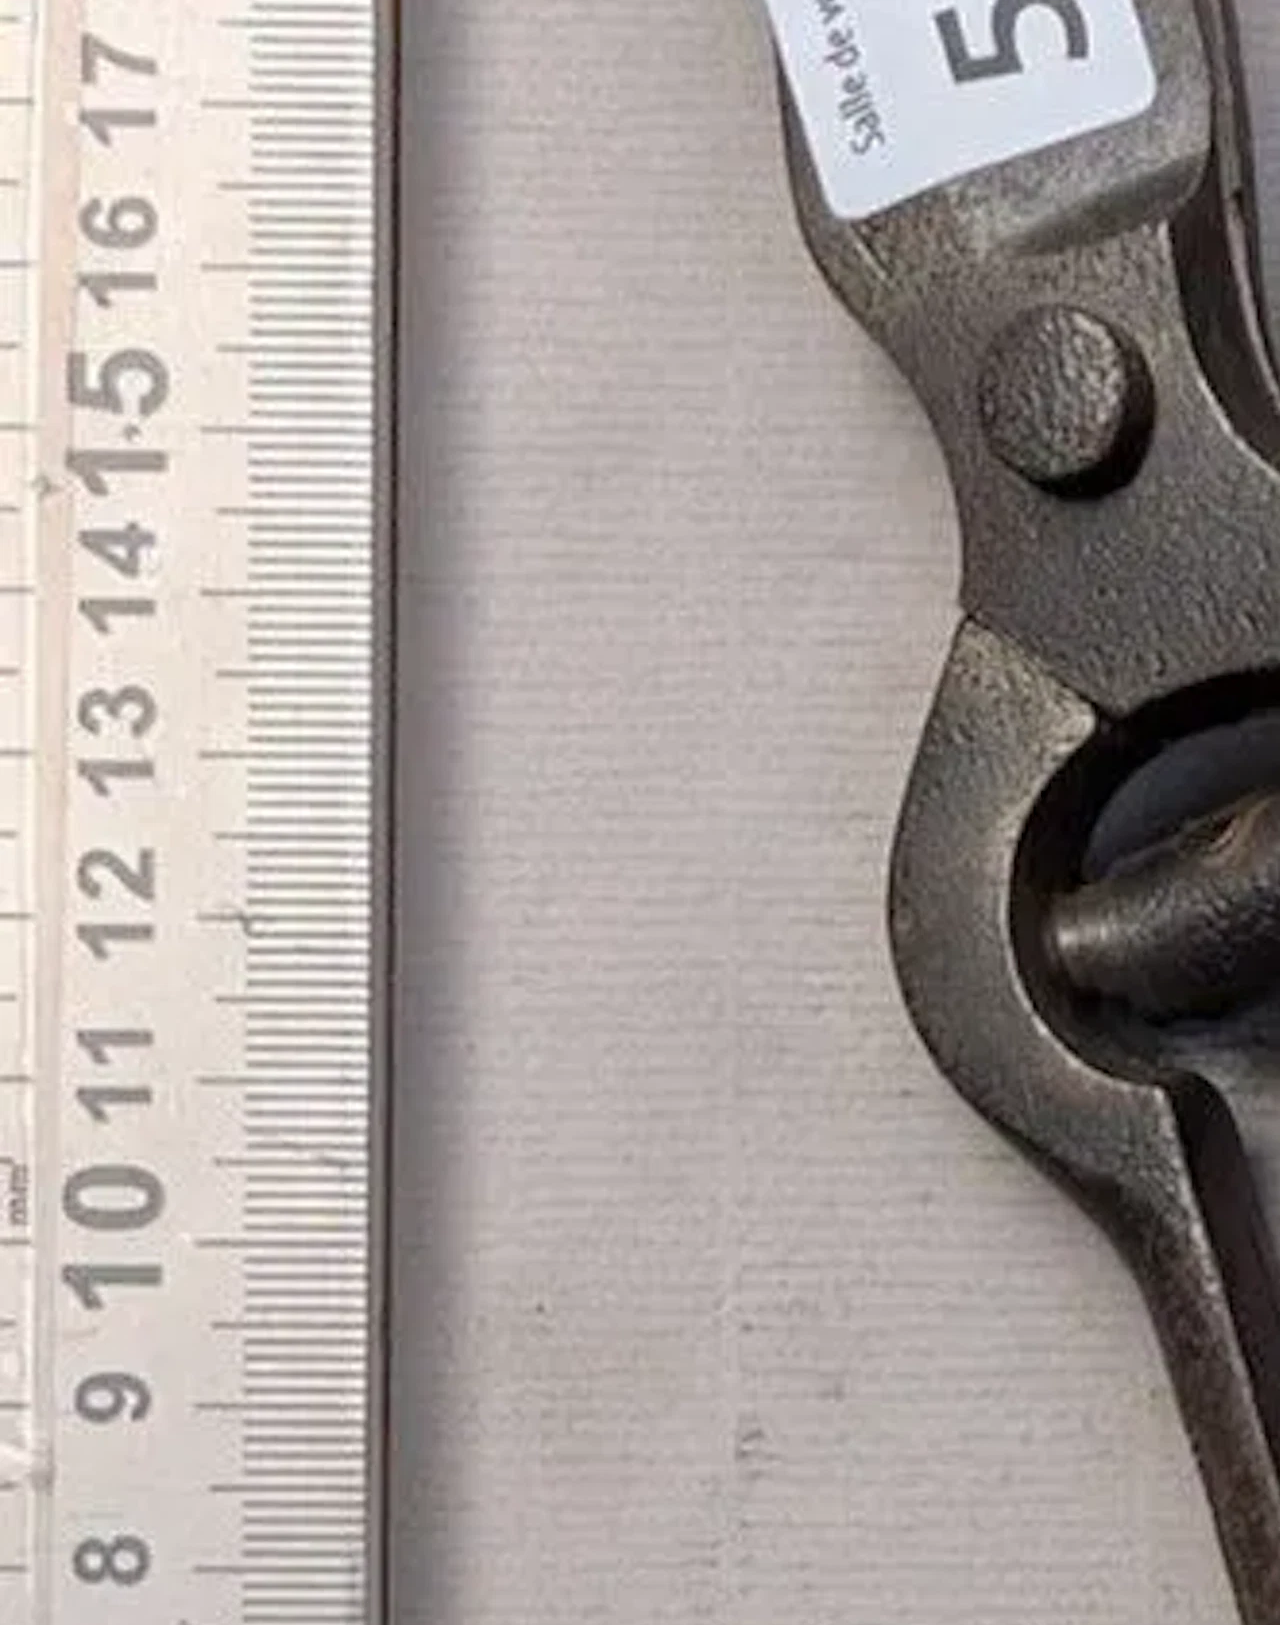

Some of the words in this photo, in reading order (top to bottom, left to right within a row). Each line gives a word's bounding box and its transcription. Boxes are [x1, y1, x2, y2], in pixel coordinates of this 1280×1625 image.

[78, 33, 157, 146] 17
[825, 28, 861, 69] de
[836, 74, 885, 156] Salle
[78, 197, 157, 309] 16
[64, 349, 168, 496] 15
[78, 522, 155, 634] 14
[78, 686, 156, 796] 13
[77, 849, 155, 959] 12
[76, 1030, 153, 1122] 11
[62, 1166, 164, 1310] 10
[75, 1373, 151, 1423] 9
[73, 1536, 149, 1586] 8
